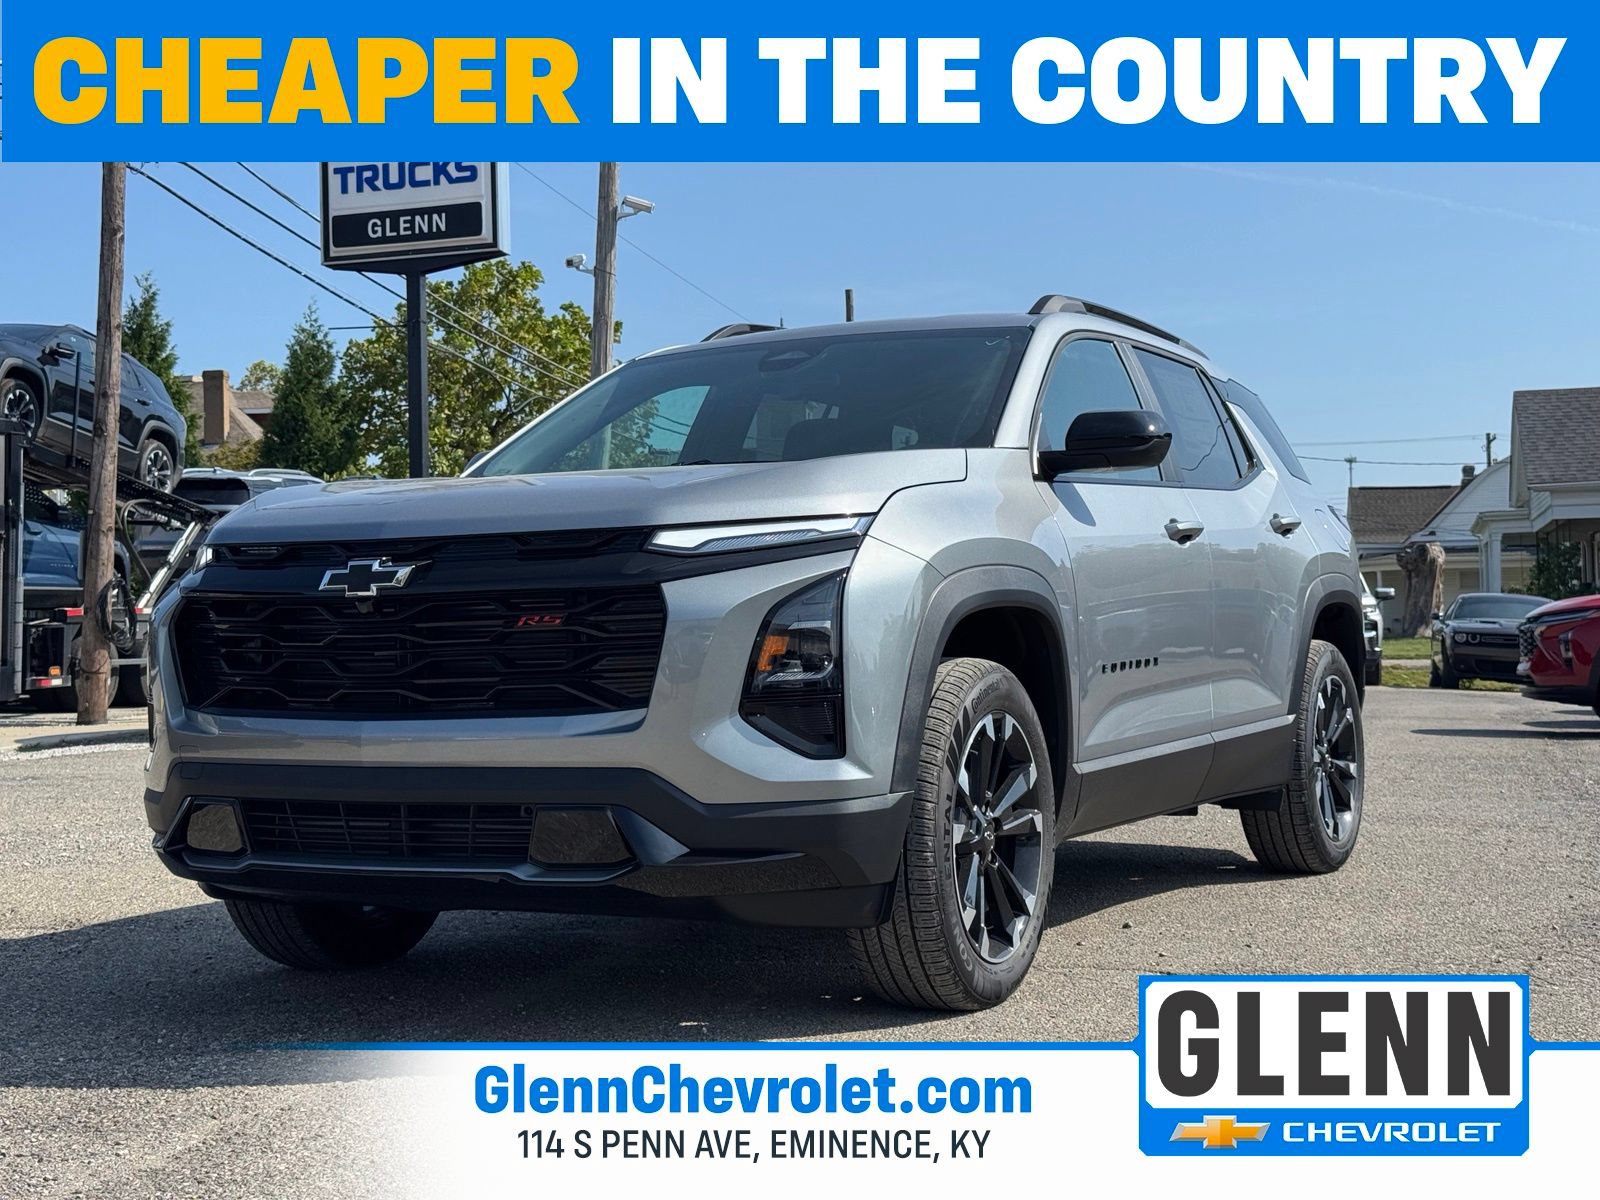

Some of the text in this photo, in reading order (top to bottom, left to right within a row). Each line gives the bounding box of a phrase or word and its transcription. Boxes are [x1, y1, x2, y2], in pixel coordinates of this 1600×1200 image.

[333, 162, 478, 194] TRUCKS
[367, 212, 447, 239] GLENN
[517, 614, 561, 626] RS
